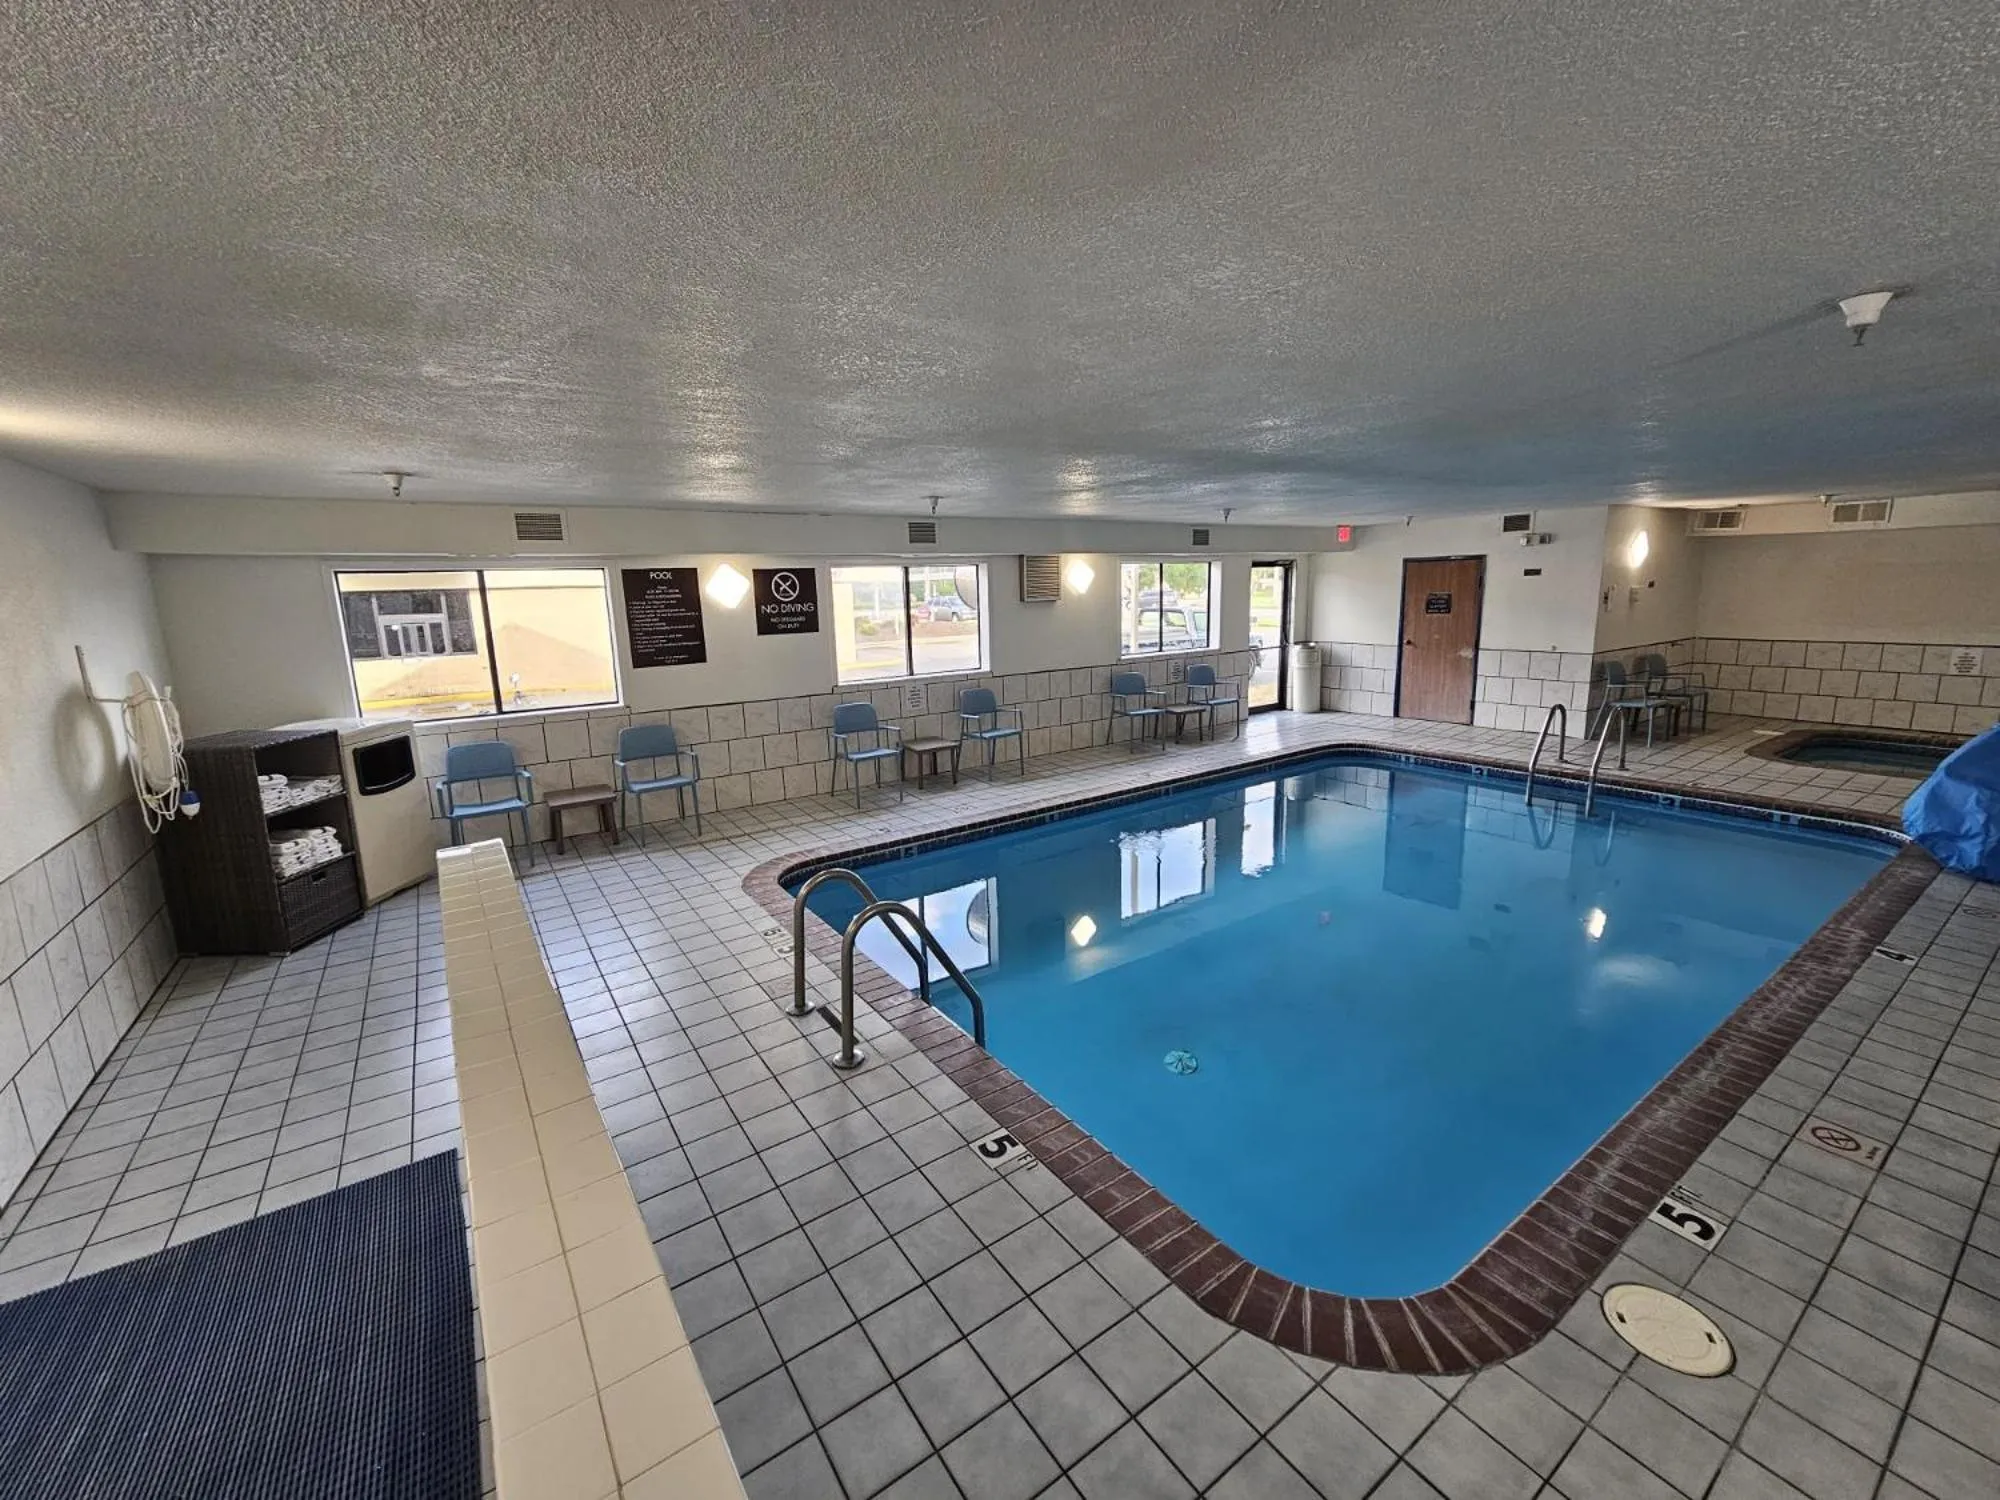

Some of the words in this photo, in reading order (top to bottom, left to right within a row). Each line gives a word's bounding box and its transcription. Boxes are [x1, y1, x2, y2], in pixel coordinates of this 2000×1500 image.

[649, 571, 673, 580] POOL
[761, 603, 779, 614] NO
[780, 601, 815, 613] DIVING
[1876, 947, 1916, 962] 4
[978, 1134, 1020, 1159] 5
[1656, 1201, 1716, 1241] 5
